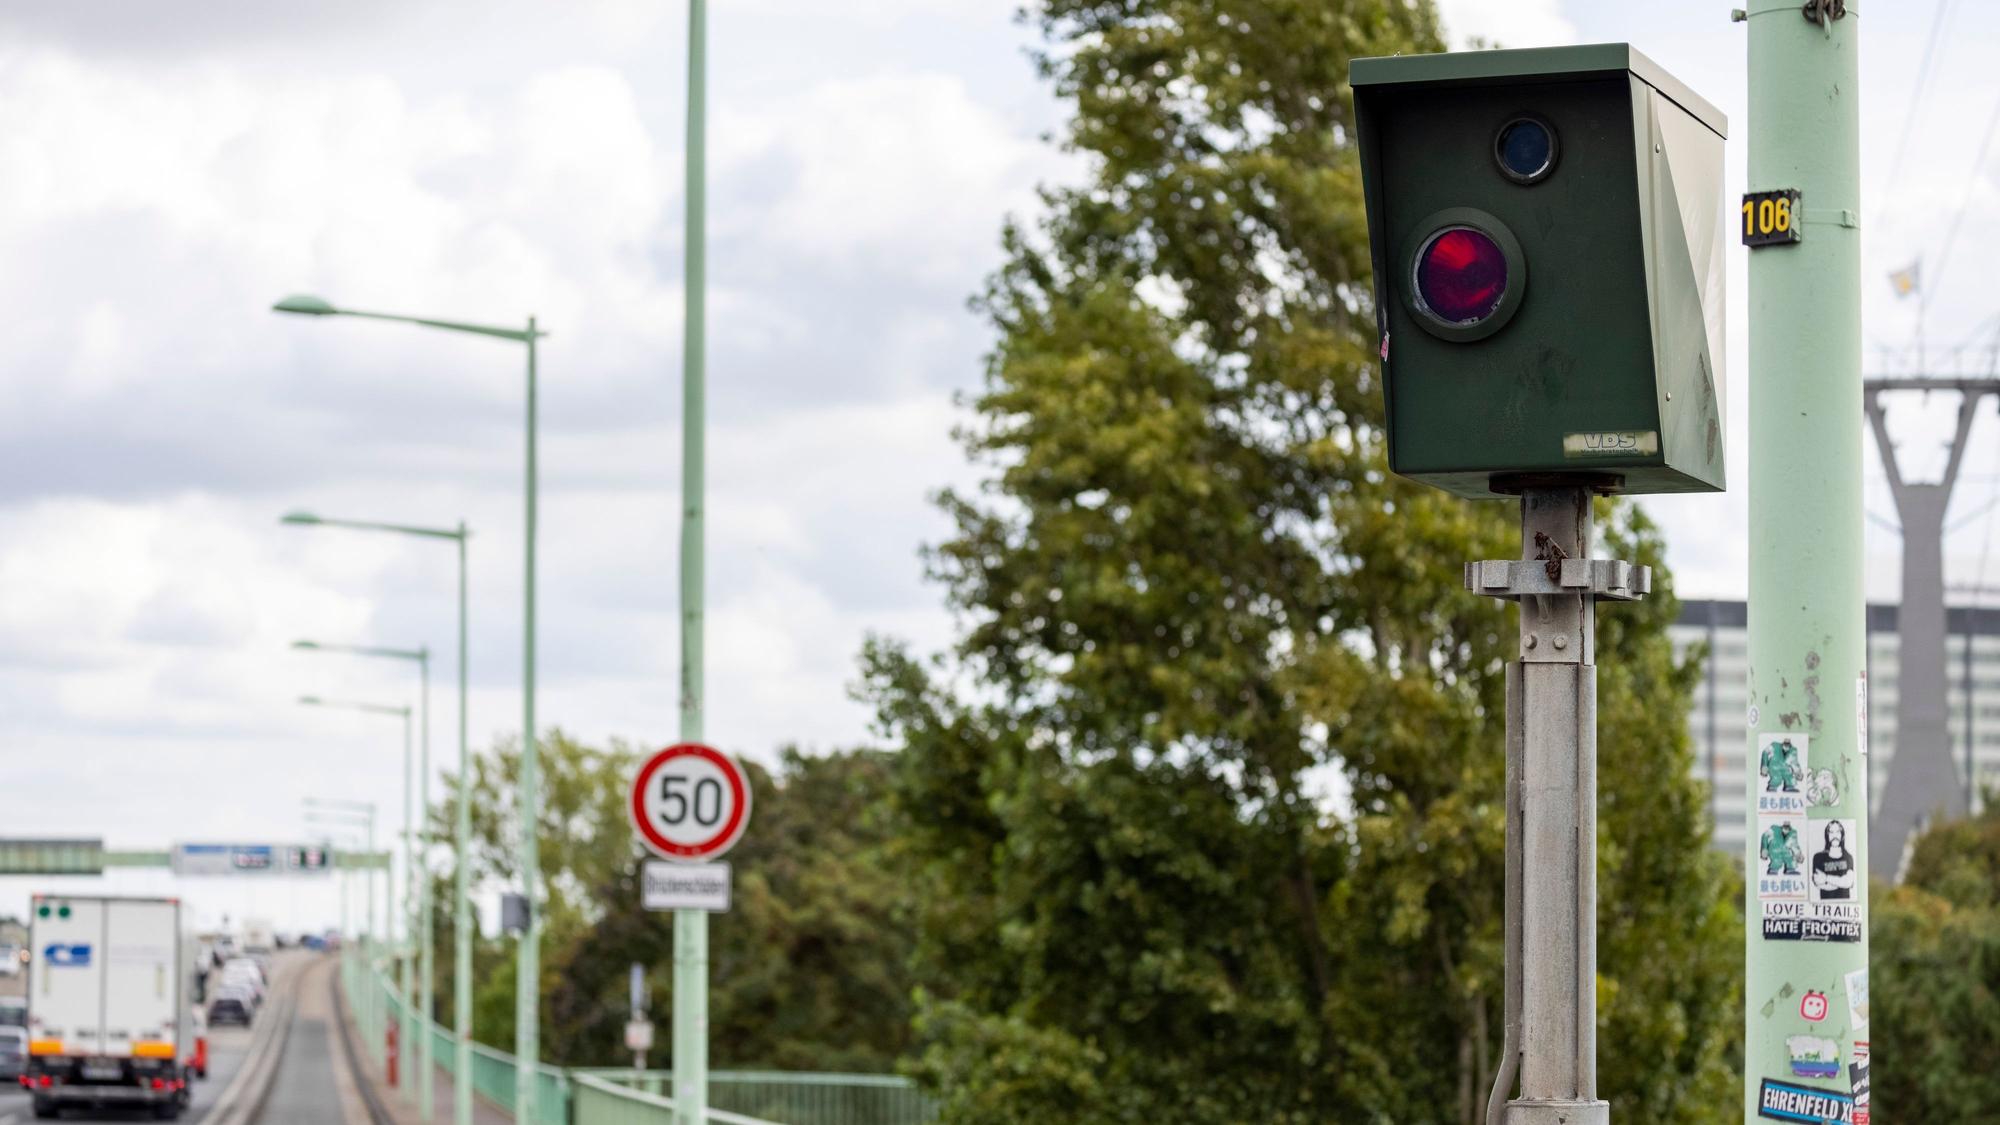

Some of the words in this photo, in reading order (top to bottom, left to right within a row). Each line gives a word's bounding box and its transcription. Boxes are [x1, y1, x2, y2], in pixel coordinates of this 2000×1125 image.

[1743, 197, 1790, 236] 106
[1583, 432, 1636, 448] VDS
[660, 776, 722, 826] 50
[1766, 903, 1804, 915] LOVE
[1812, 904, 1860, 918] TRAILS
[1765, 920, 1799, 934] HATE
[1801, 921, 1860, 937] FRONTEX
[1763, 1087, 1839, 1119] EHRENFELD
